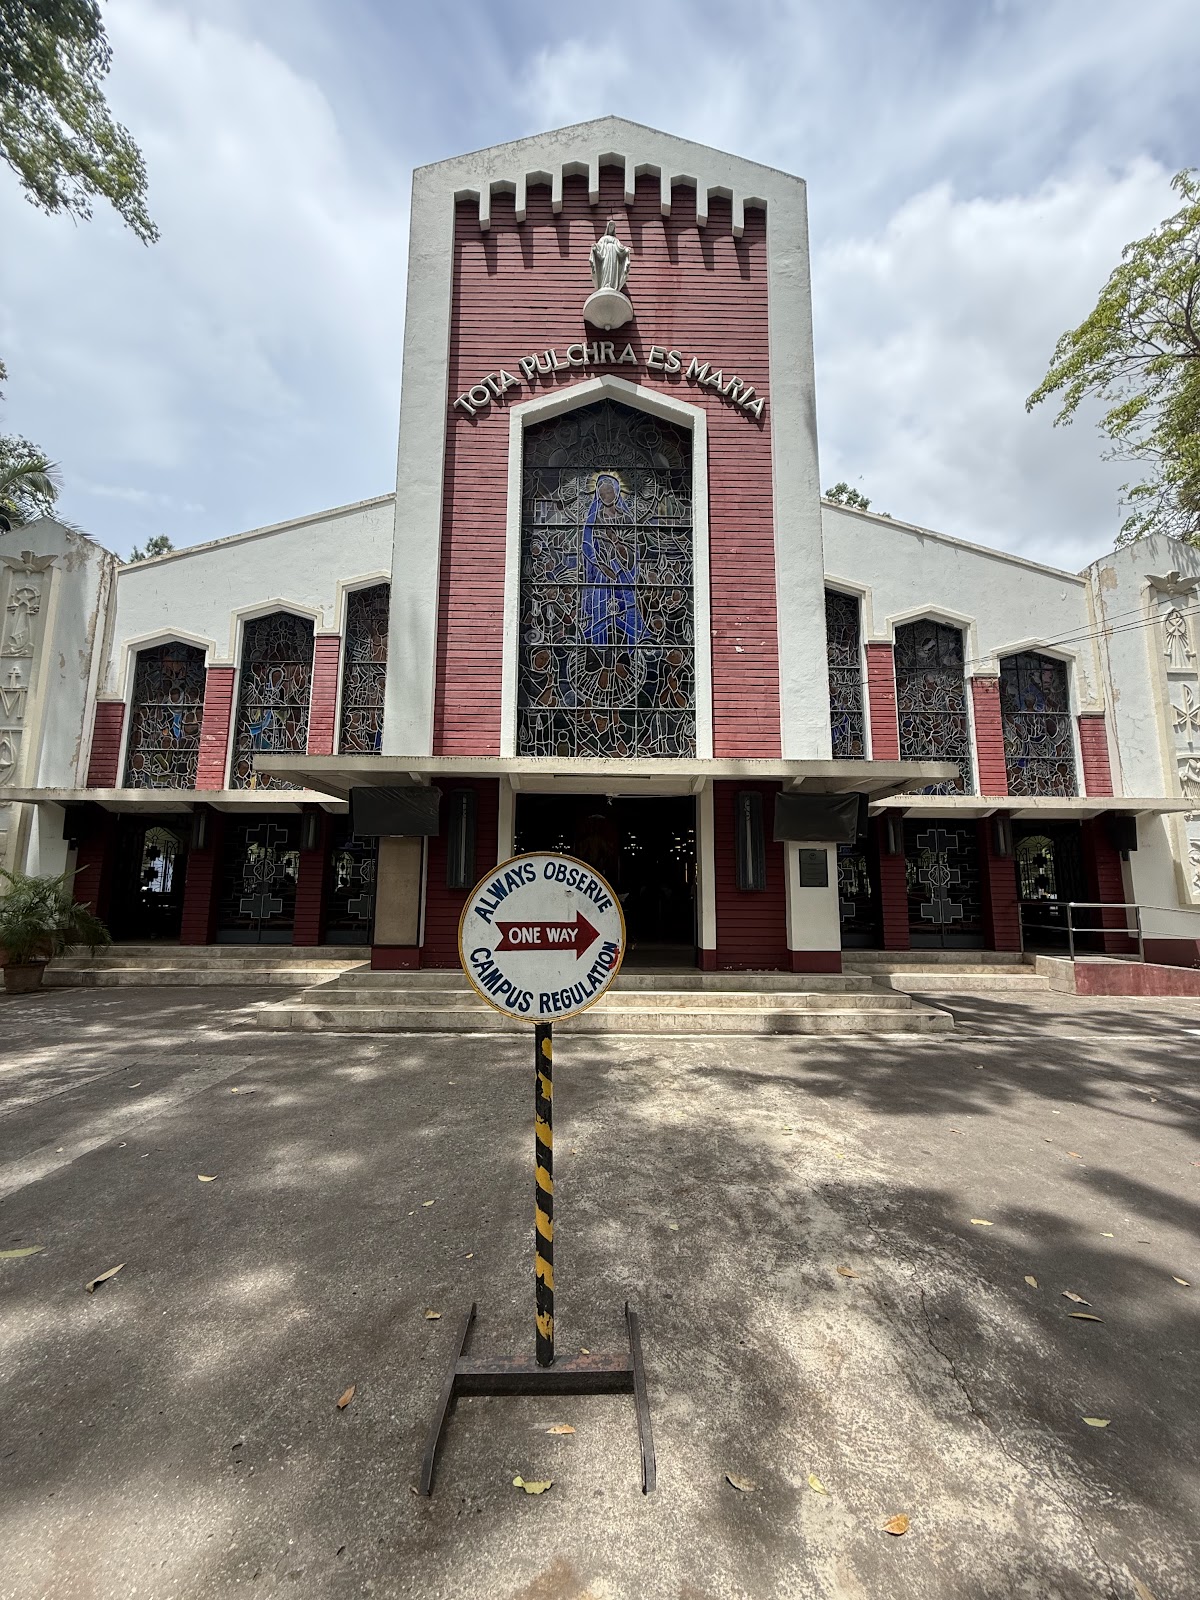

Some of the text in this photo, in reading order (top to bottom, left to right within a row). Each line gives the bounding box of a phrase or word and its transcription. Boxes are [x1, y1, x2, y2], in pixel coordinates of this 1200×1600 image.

[453, 341, 767, 420] TOTA PULCHRA ES MARIA
[474, 861, 613, 924] ALWAYS OBSERVE
[508, 927, 578, 944] ONE WAY
[470, 941, 618, 1013] CAMPUS REGULATION
